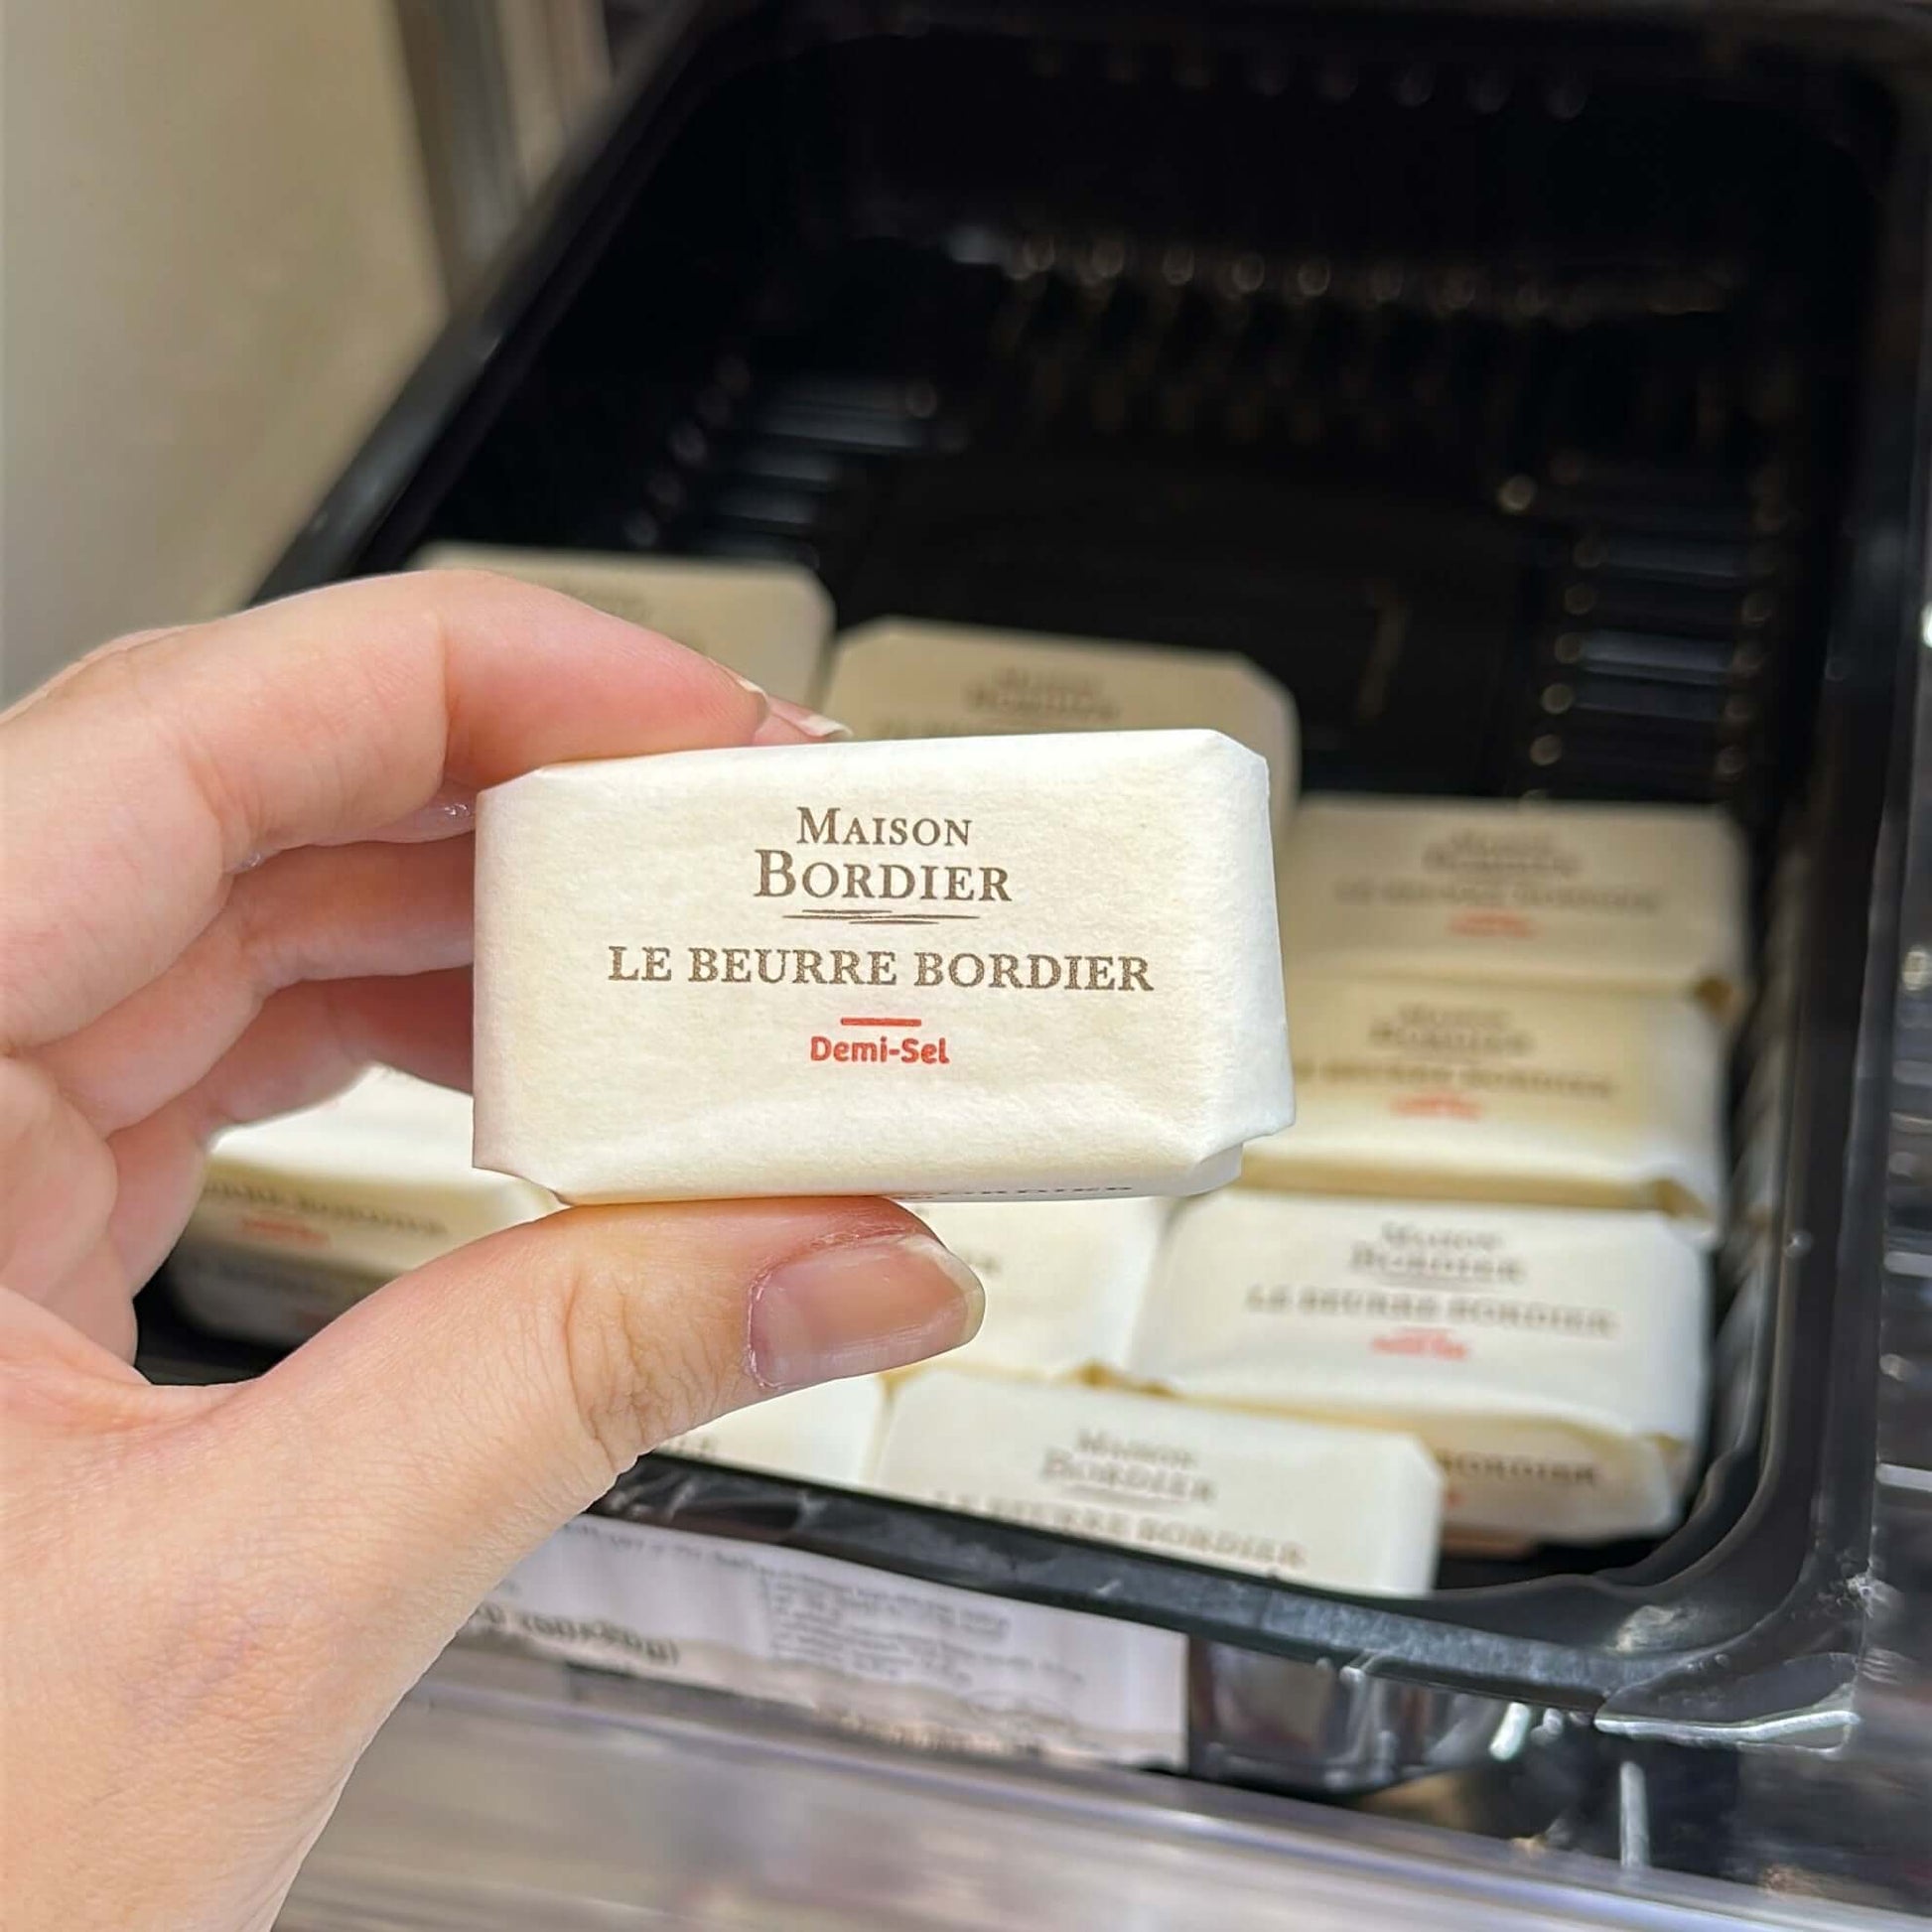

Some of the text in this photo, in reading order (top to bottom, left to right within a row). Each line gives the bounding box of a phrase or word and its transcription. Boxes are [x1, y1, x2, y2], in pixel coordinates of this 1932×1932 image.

[796, 806, 973, 845] MAISON
[754, 848, 1013, 902] BORDIER
[608, 945, 1155, 991] LE BEURRE BORDIER
[809, 1035, 950, 1065] Demi-Sel
